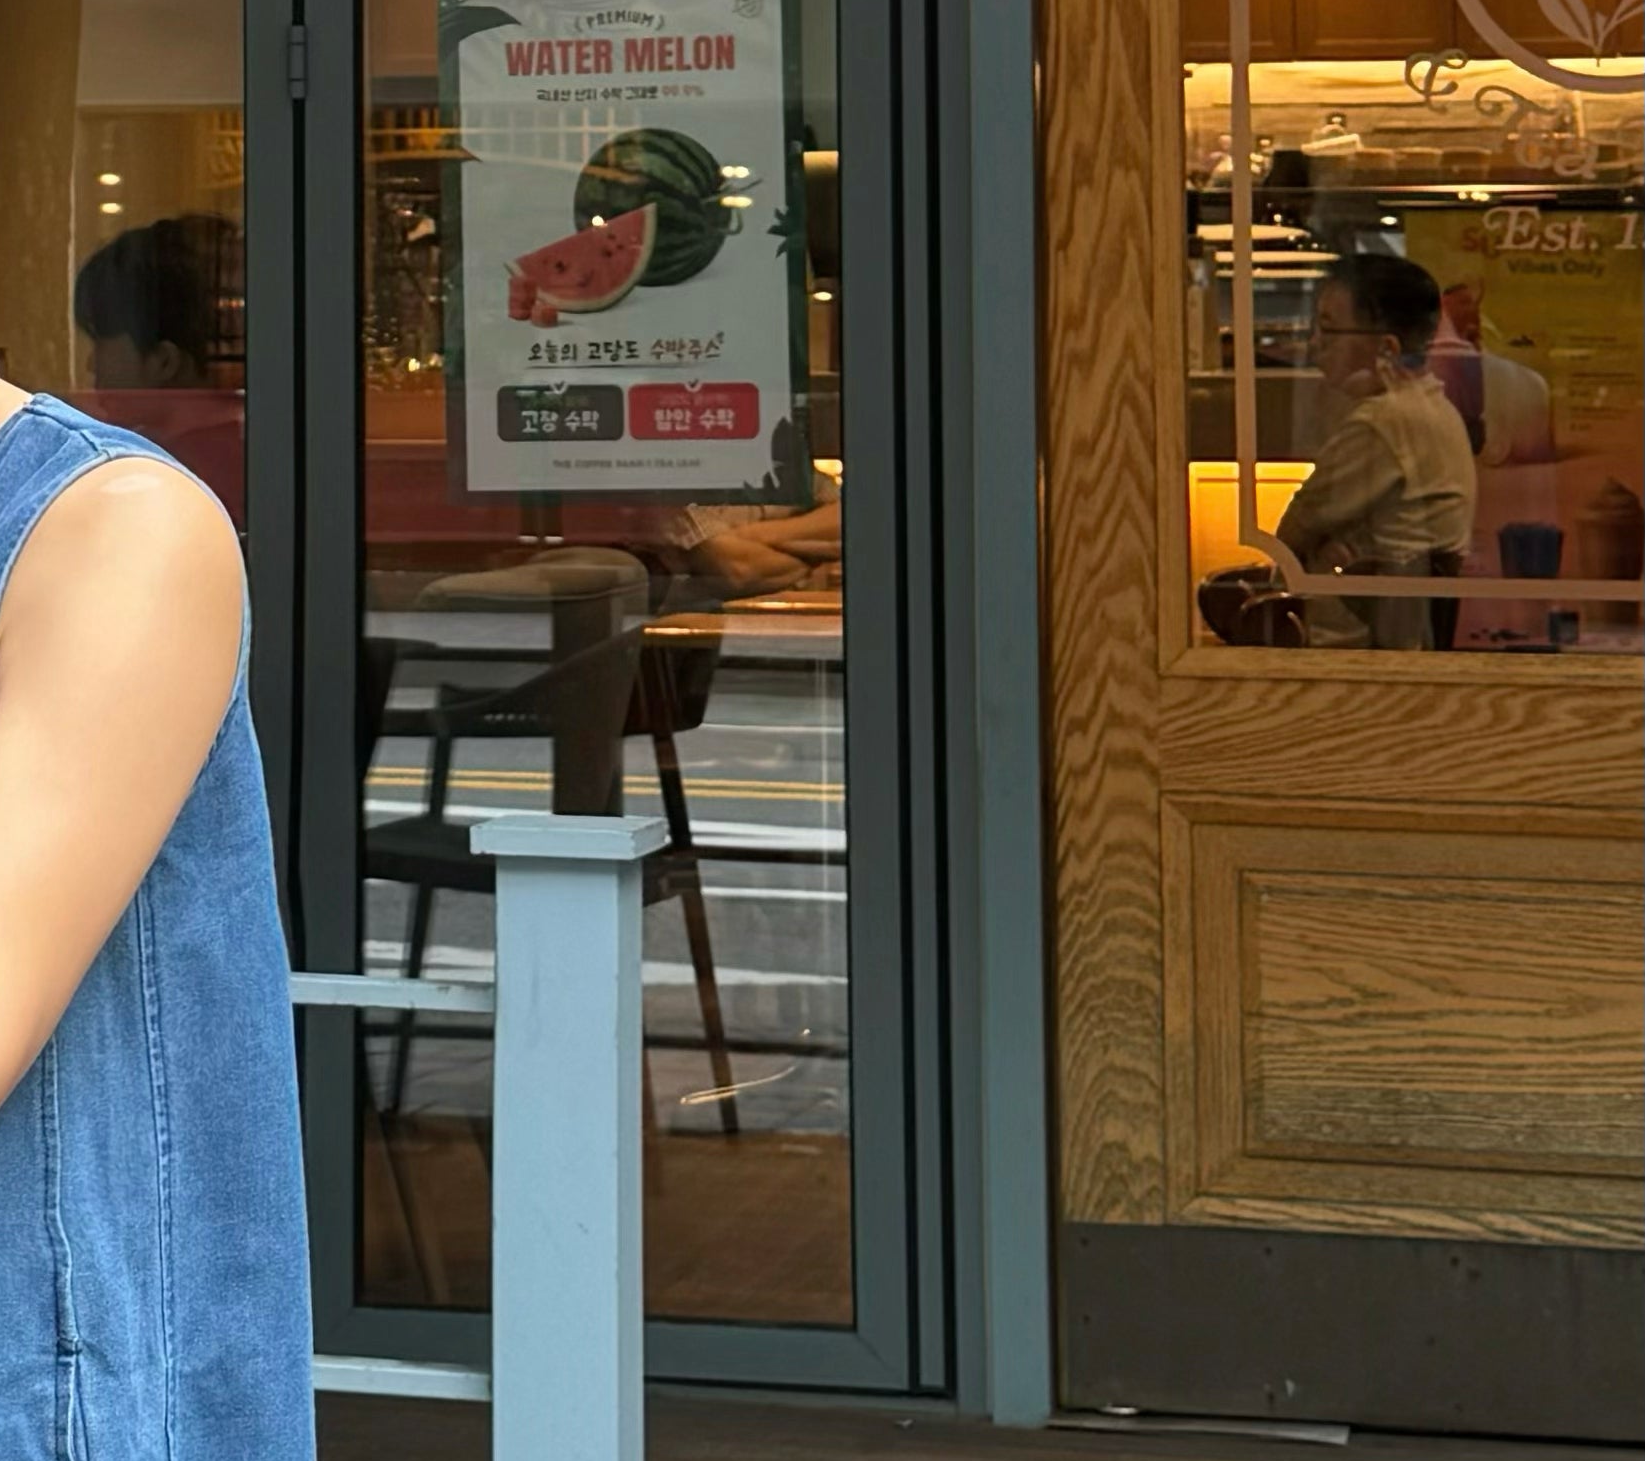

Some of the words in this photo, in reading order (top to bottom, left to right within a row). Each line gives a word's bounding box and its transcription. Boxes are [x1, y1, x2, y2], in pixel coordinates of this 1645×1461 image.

[585, 10, 656, 30] PREMIUM
[506, 39, 614, 77] WATER
[624, 34, 736, 73] MELON
[1483, 205, 1599, 252] Est.
[527, 340, 578, 364] 오늘의
[587, 339, 640, 362] 고당도
[650, 337, 721, 361] 수박주스
[565, 410, 600, 432] 수박
[699, 408, 735, 431] 수박
